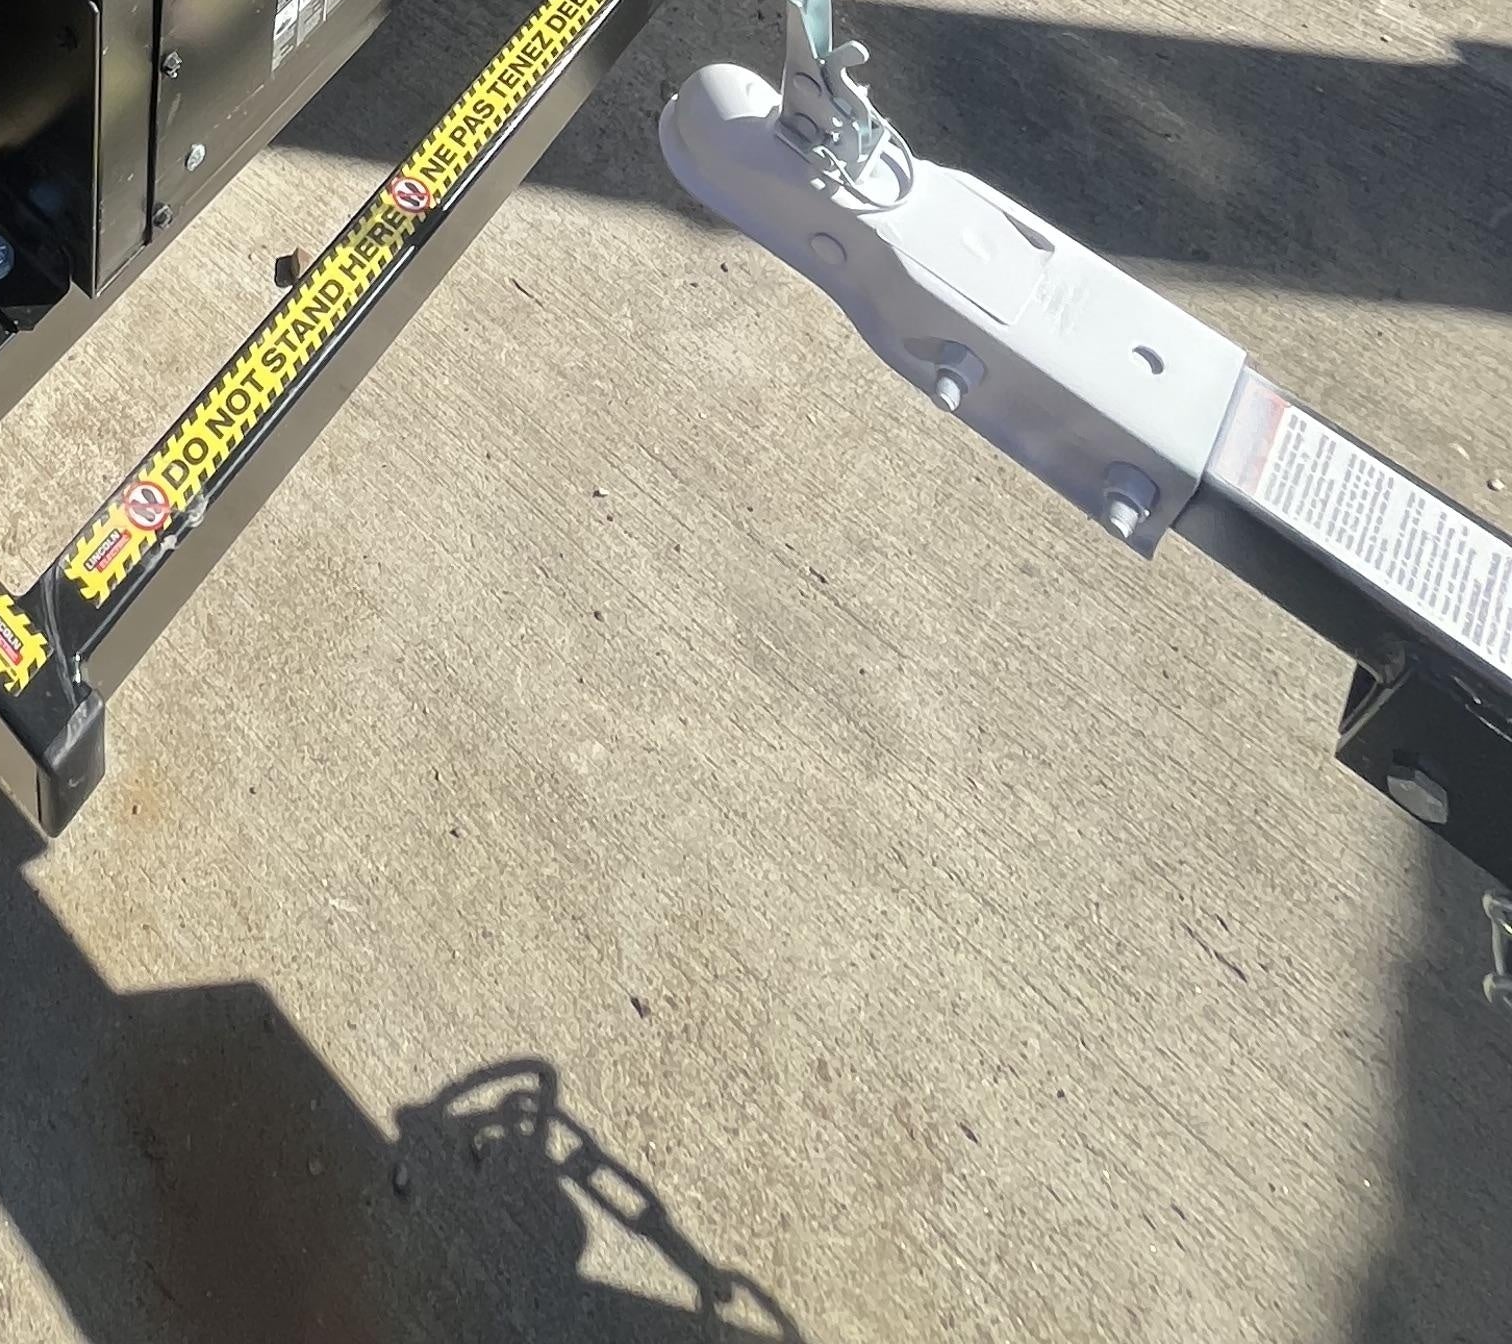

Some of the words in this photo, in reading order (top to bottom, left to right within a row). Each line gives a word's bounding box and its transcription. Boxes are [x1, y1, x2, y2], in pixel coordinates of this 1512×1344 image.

[421, 145, 458, 184] NE
[454, 90, 499, 146] PAS
[489, 30, 552, 101] TENEZ
[163, 439, 208, 489] DO
[205, 371, 265, 438] NOT
[262, 277, 345, 375] STAND
[341, 206, 406, 284] HERE
[85, 528, 122, 571] LINCOLN
